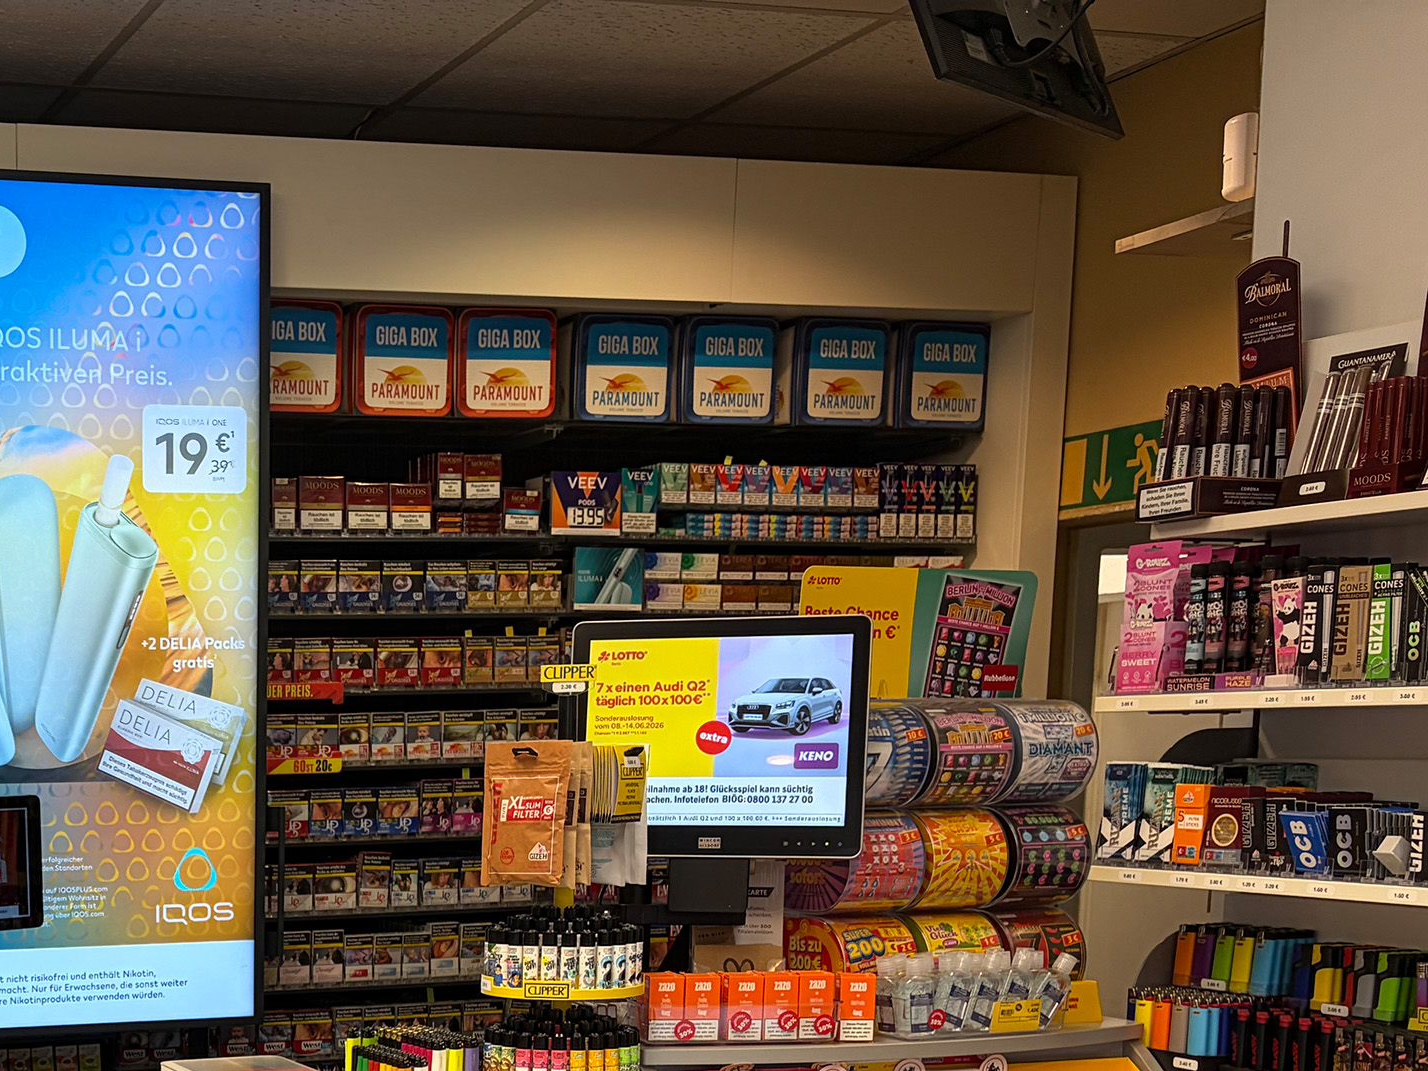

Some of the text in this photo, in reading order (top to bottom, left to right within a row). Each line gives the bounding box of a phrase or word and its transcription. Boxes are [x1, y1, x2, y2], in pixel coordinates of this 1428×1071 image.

[1250, 311, 1287, 324] DOMINICAN
[49, 329, 128, 352] ILUMA
[376, 326, 438, 347] GIGA BOX
[598, 335, 659, 356] GIGA BOX
[1338, 350, 1397, 370] GUANTANAMERA
[110, 363, 173, 386] Preis.
[371, 382, 440, 400] PARAMOUNT
[592, 391, 660, 407] PARAMOUNT
[568, 477, 607, 490] VEEV
[1308, 584, 1334, 594] CONES
[1301, 600, 1318, 655] GIZEH
[141, 637, 245, 652] +2 DELIA Packs
[1121, 658, 1157, 667] SWEET
[1122, 651, 1153, 660] BERRY
[596, 683, 603, 693] 7
[606, 685, 612, 693] x
[615, 682, 650, 693] einen
[654, 681, 684, 693] Audi
[1167, 682, 1210, 691] SUNRISE
[596, 695, 636, 708] täglich
[595, 714, 654, 723] Sonderauslosung
[611, 721, 664, 730] 08.-14.06.2026
[700, 732, 728, 744] extra
[798, 751, 833, 761] KENO
[1029, 742, 1093, 757] DIAMANT
[683, 783, 813, 795] ab 18! Glücksspiel kann süchtig
[674, 793, 813, 804] Infotelefon BIÖG: 0800 137 27 00
[1336, 813, 1353, 869] OCB
[155, 902, 235, 926] IQOS
[6, 972, 28, 983] nicht
[31, 970, 68, 983] risikofrei
[71, 971, 86, 982] und
[88, 968, 121, 981] enthält
[123, 968, 157, 981] Nikotin,
[32, 983, 47, 995] Nur
[49, 982, 61, 994] für
[64, 980, 118, 994] Erwachsene,
[120, 980, 133, 991] die
[135, 979, 158, 990] sonst
[160, 977, 188, 989] weiter
[527, 984, 568, 997] CLIPPER
[10, 993, 80, 1006] Nikotinprodukte
[83, 991, 130, 1003] verwenden
[132, 990, 165, 1001] würden.
